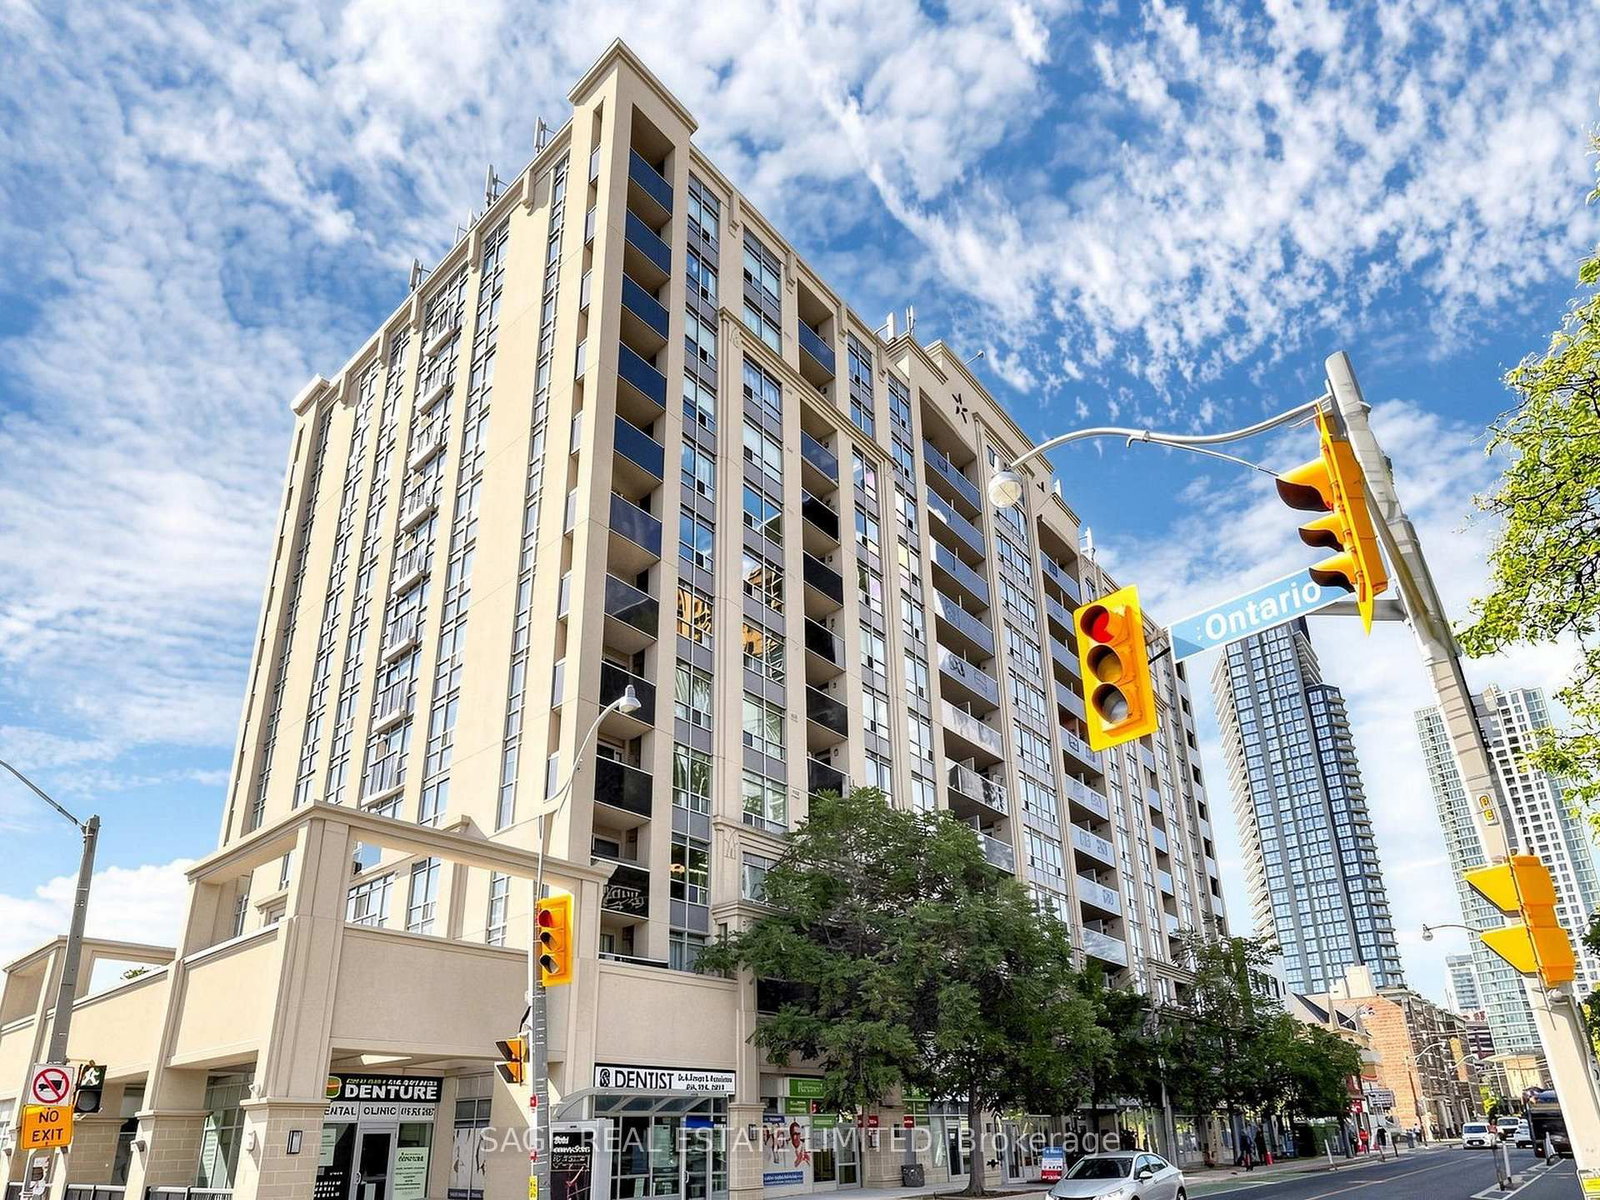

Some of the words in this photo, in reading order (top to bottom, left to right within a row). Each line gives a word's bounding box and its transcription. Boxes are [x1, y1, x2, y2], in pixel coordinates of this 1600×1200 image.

[1205, 581, 1321, 641] Ontario
[615, 1070, 674, 1089] DENTIST
[345, 1084, 438, 1099] DENTURE
[39, 1110, 59, 1124] NO
[324, 1106, 356, 1116] ENTAL
[363, 1106, 397, 1115] CLINIC
[31, 1128, 64, 1142] EXIT
